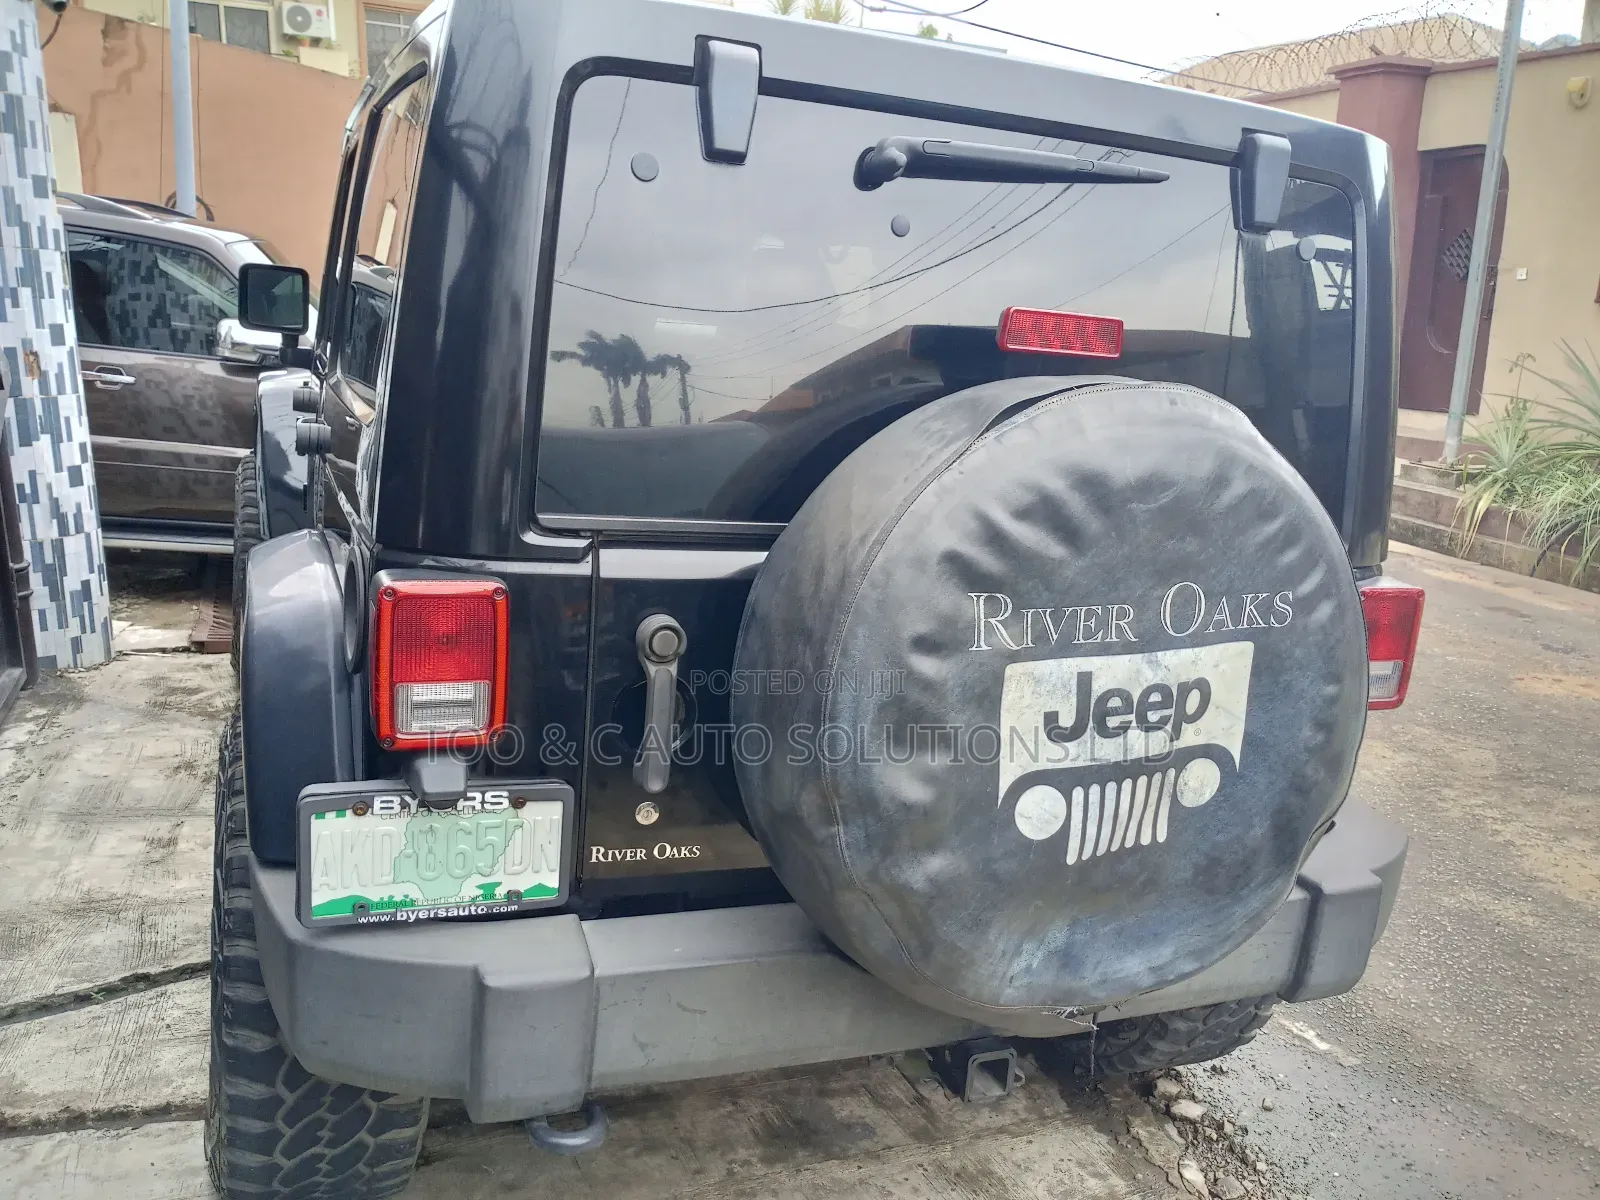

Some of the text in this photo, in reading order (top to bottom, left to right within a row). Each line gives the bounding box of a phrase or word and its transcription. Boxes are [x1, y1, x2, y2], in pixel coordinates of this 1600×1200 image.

[1043, 671, 1212, 743] Jeep
[373, 790, 510, 814] BYRS
[370, 900, 409, 910] FEDERAL
[411, 897, 451, 907] REPUBLIC
[469, 893, 502, 902] NIGERIA
[357, 904, 519, 924] www.byersauto.com
